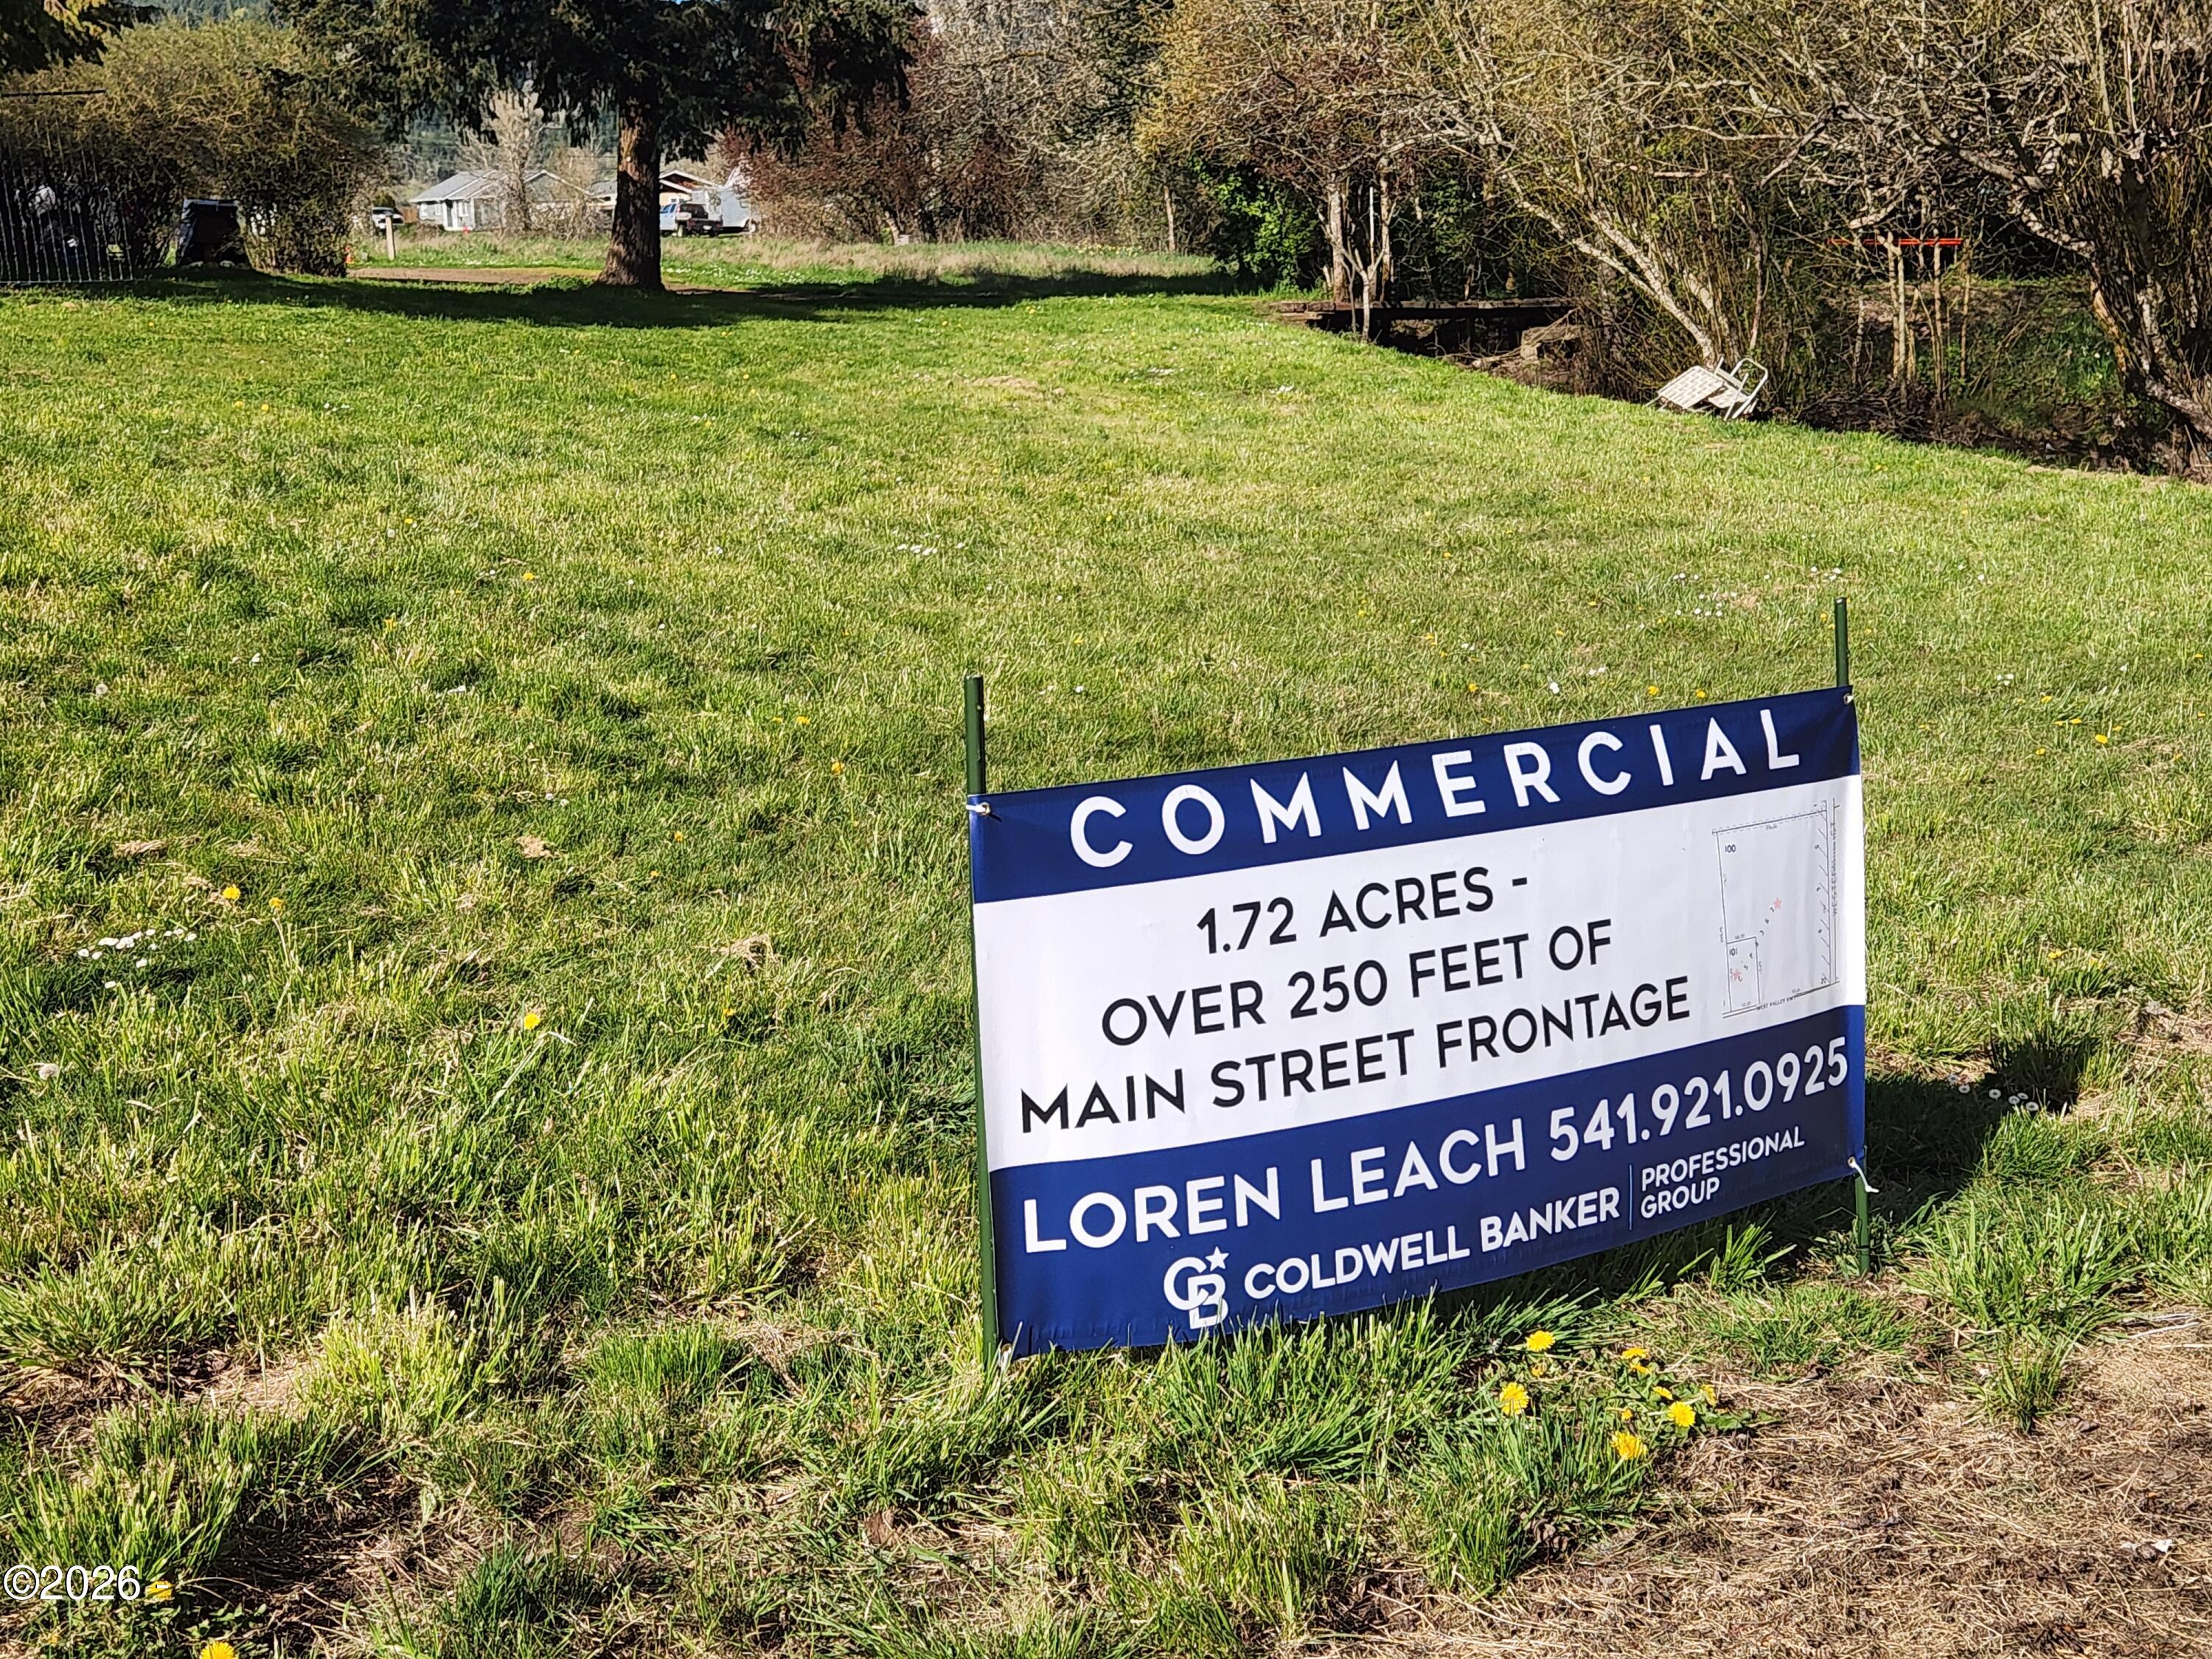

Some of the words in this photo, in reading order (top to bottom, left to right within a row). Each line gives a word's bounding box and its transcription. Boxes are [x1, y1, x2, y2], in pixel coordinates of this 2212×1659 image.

[1071, 709, 1799, 867] COMMERCIAL
[1725, 844, 1736, 853] 100
[1197, 897, 1296, 953] 1.72
[1320, 867, 1493, 936] ACRES
[1512, 877, 1528, 886] -
[1102, 981, 1265, 1046] OVER
[1288, 960, 1387, 1018] 250
[1410, 933, 1528, 997] FEET
[1550, 919, 1610, 970] OF
[1022, 1069, 1184, 1133] MAIN
[1211, 1029, 1414, 1107] STREET
[1437, 976, 1689, 1068] FRONTAGE
[1024, 1167, 1279, 1253] LOREN
[1311, 1119, 1525, 1212] LEACH
[1551, 1037, 1847, 1161] 541.921.0925
[1641, 1178, 1719, 1219] GROUP
[1642, 1127, 1804, 1191] PROFESSIONAL
[1245, 1226, 1470, 1298] COLDWELL
[1481, 1187, 1619, 1252] BANKER
